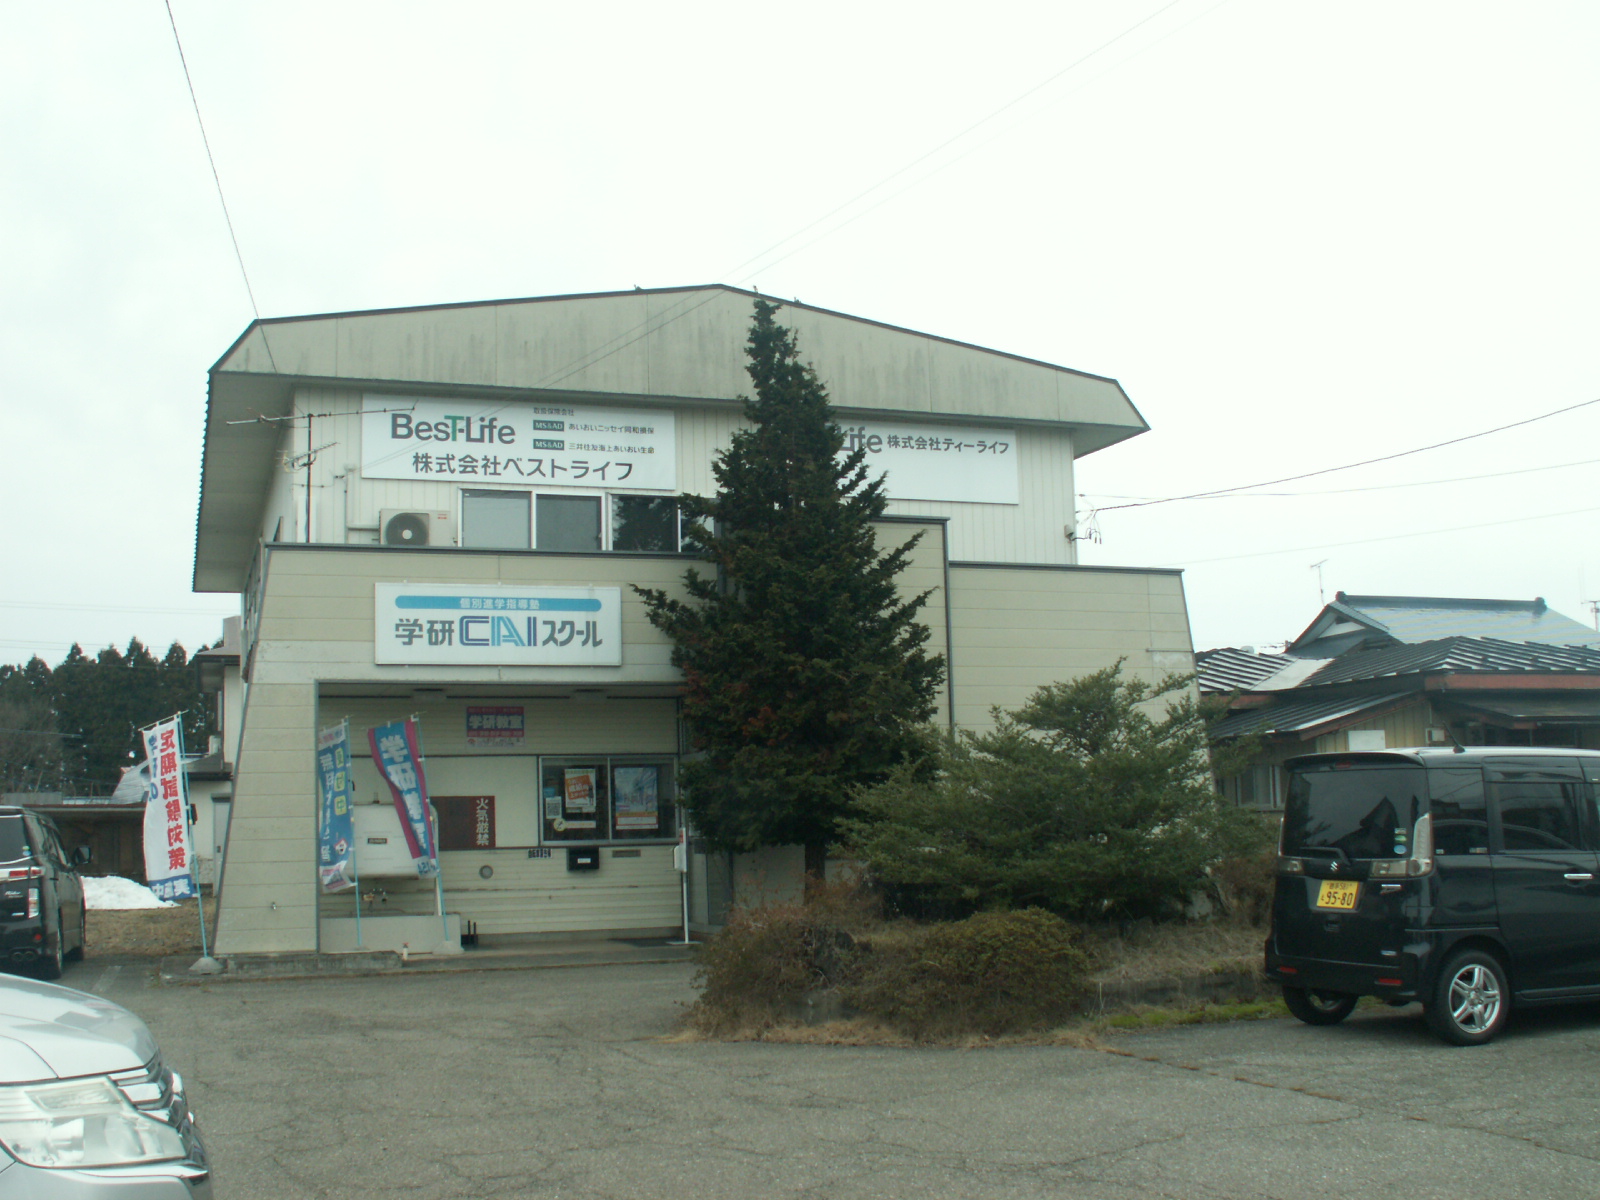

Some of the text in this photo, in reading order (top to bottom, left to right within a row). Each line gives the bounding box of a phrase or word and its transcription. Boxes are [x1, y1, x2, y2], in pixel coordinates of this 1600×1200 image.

[534, 421, 655, 435] MS&AD あいおいニッセイ同和損保
[534, 440, 655, 454] MS&AD 三井住友海上あいおい生命
[887, 434, 1010, 454] 株式会社ティーライフ
[412, 452, 634, 480] 株式会社ベストライフ
[459, 597, 541, 611] 個別進学指導塾
[476, 797, 490, 846] 火気厳禁
[1325, 891, 1353, 906] 95-80
